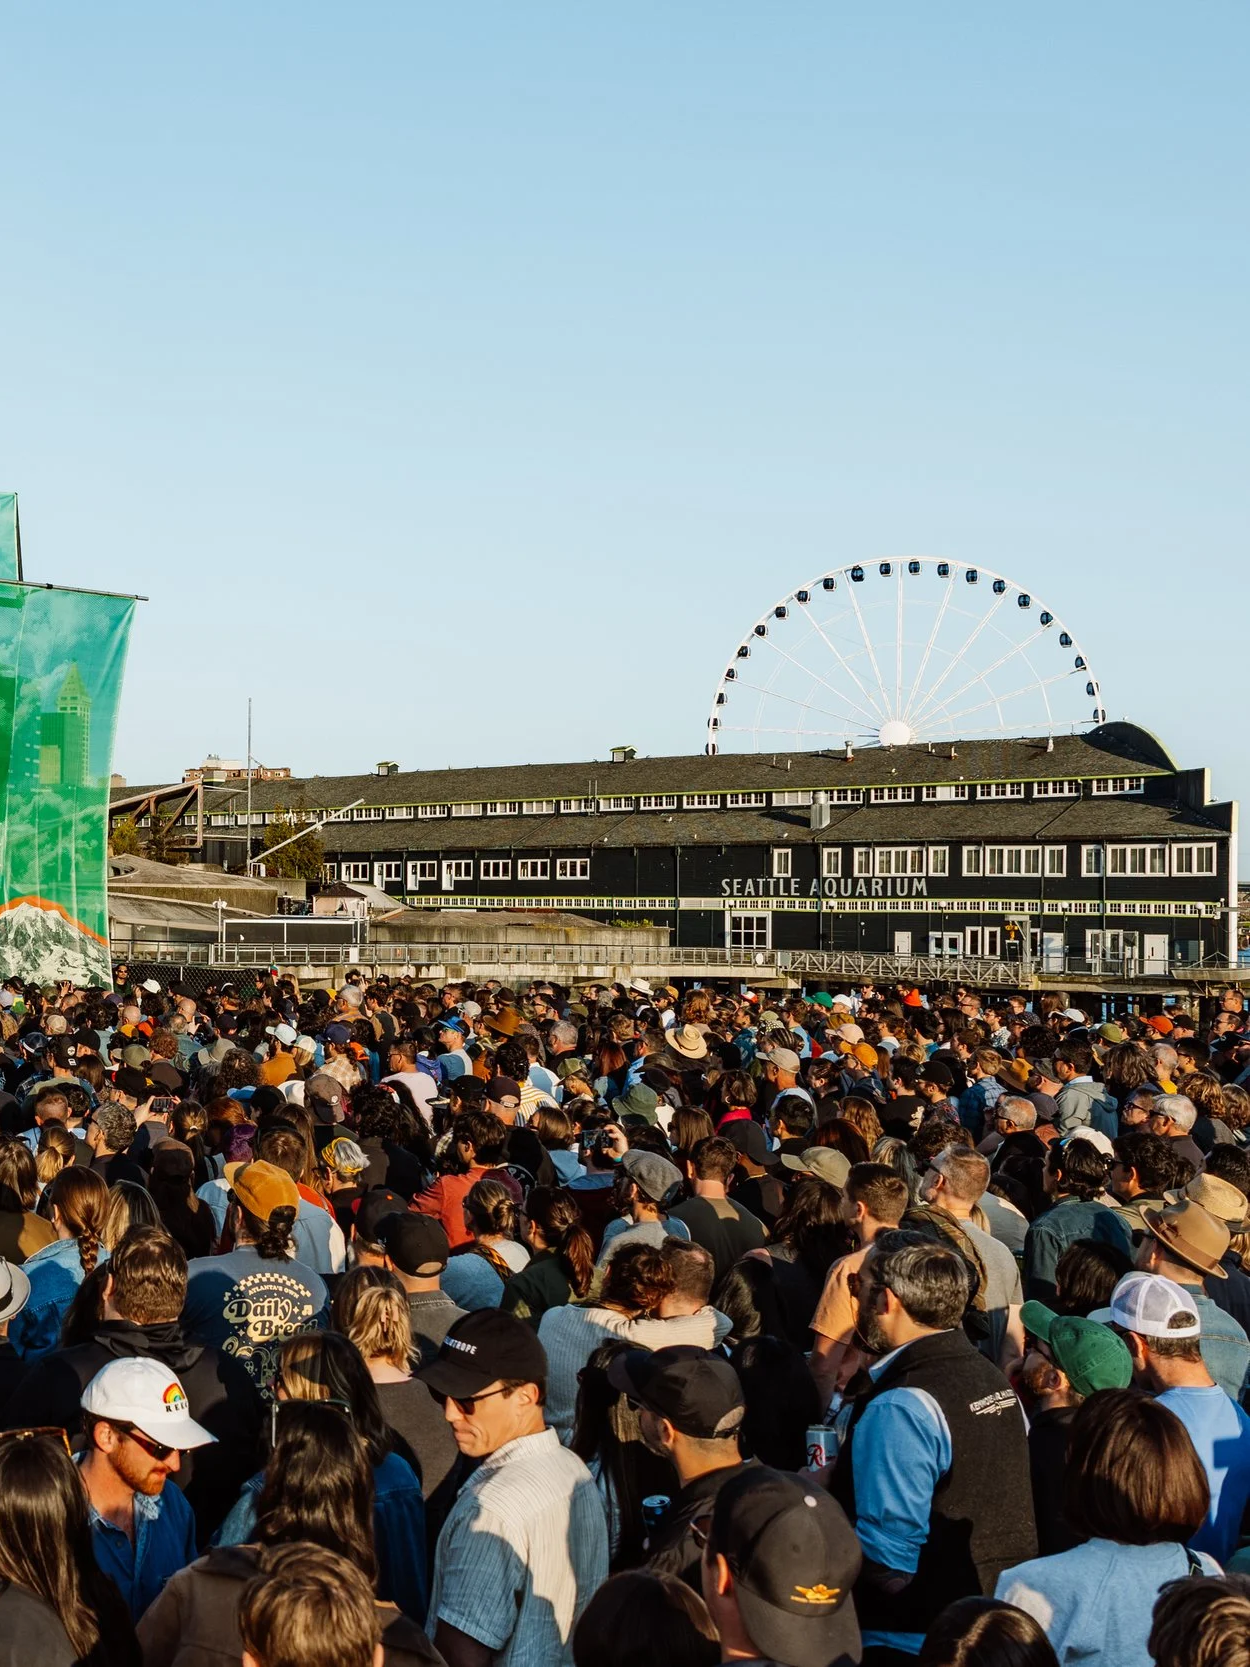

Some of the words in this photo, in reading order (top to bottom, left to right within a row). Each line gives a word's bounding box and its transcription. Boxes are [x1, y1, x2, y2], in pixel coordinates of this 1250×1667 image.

[720, 878, 800, 896] SEATTLE
[809, 877, 928, 898] AQUARIUM
[248, 1284, 283, 1296] ATLANTA'S
[284, 1287, 300, 1299] OWN
[227, 1298, 291, 1321] Daily
